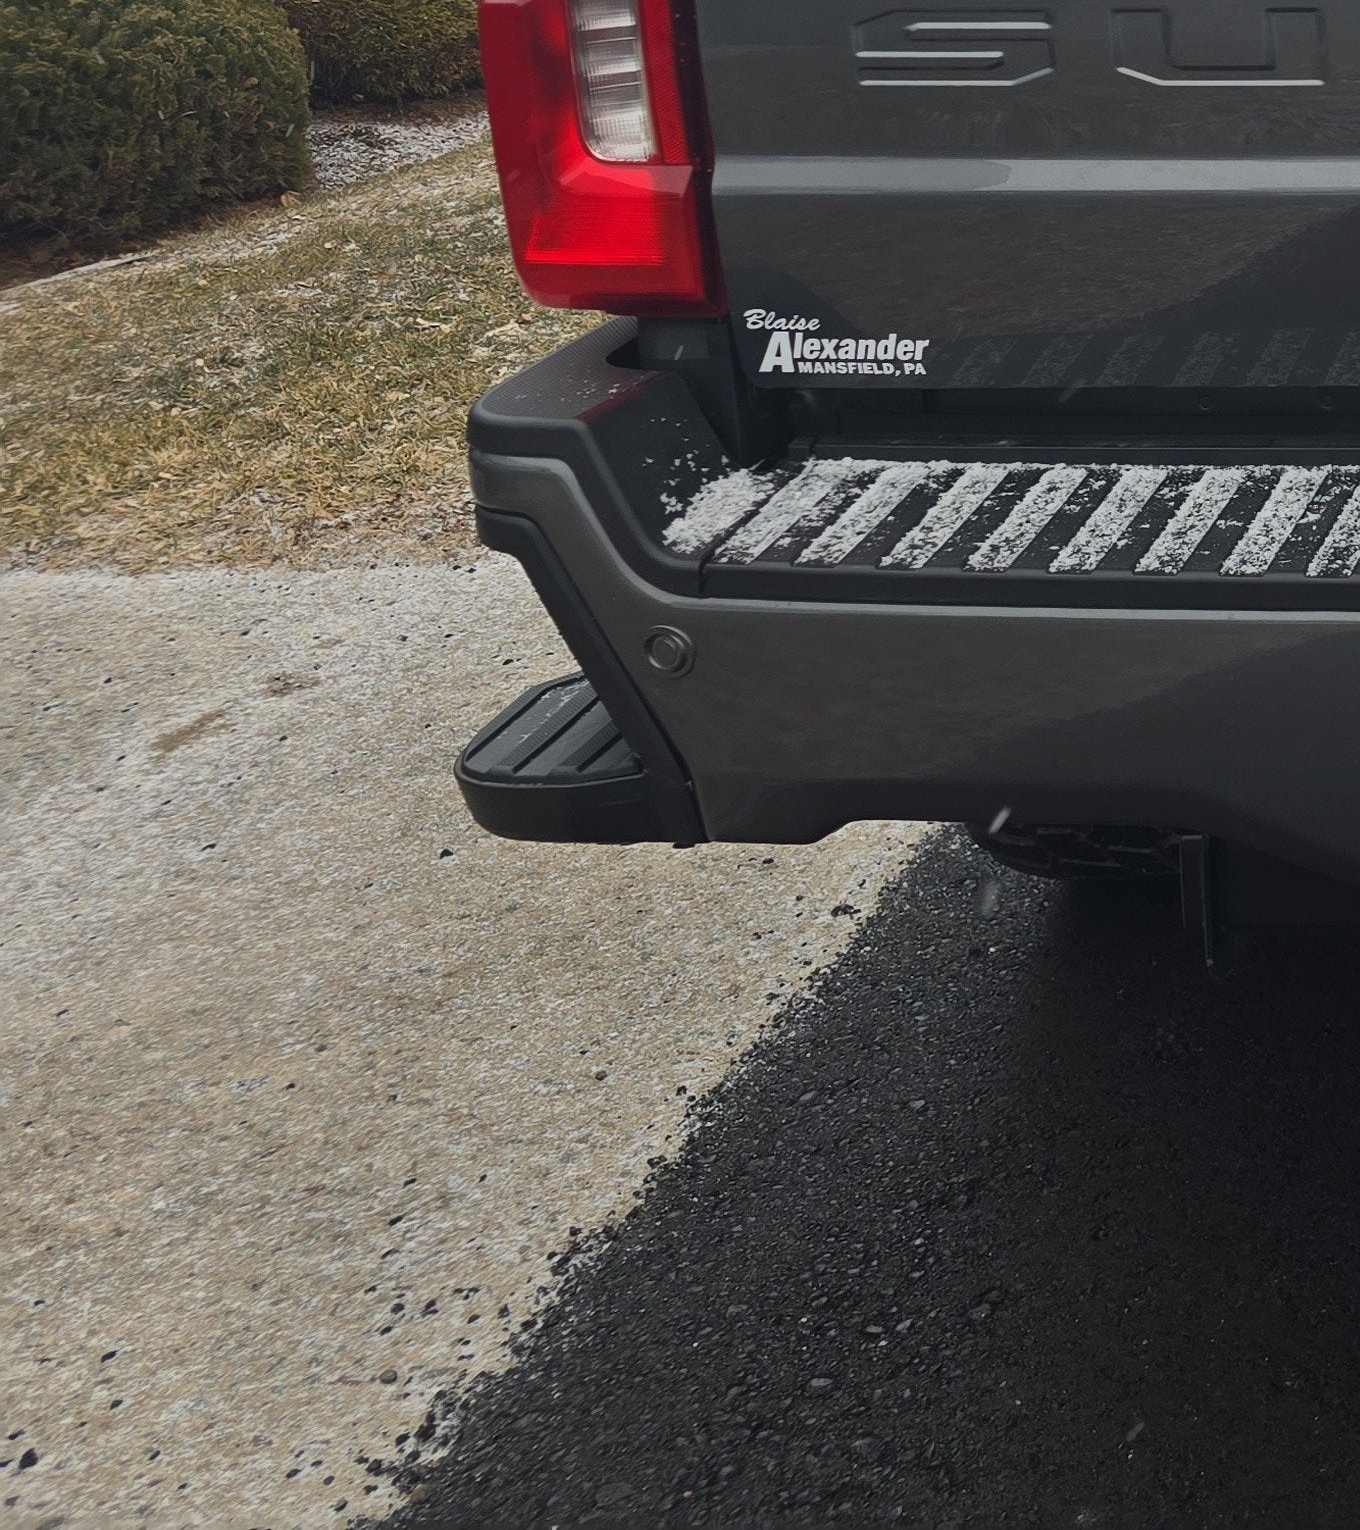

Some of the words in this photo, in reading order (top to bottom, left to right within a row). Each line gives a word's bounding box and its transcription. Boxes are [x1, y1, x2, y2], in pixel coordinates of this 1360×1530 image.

[743, 308, 820, 331] Blaise
[759, 331, 930, 373] Alexander
[798, 361, 900, 376] MANSFIELD,
[903, 362, 927, 375] PA
